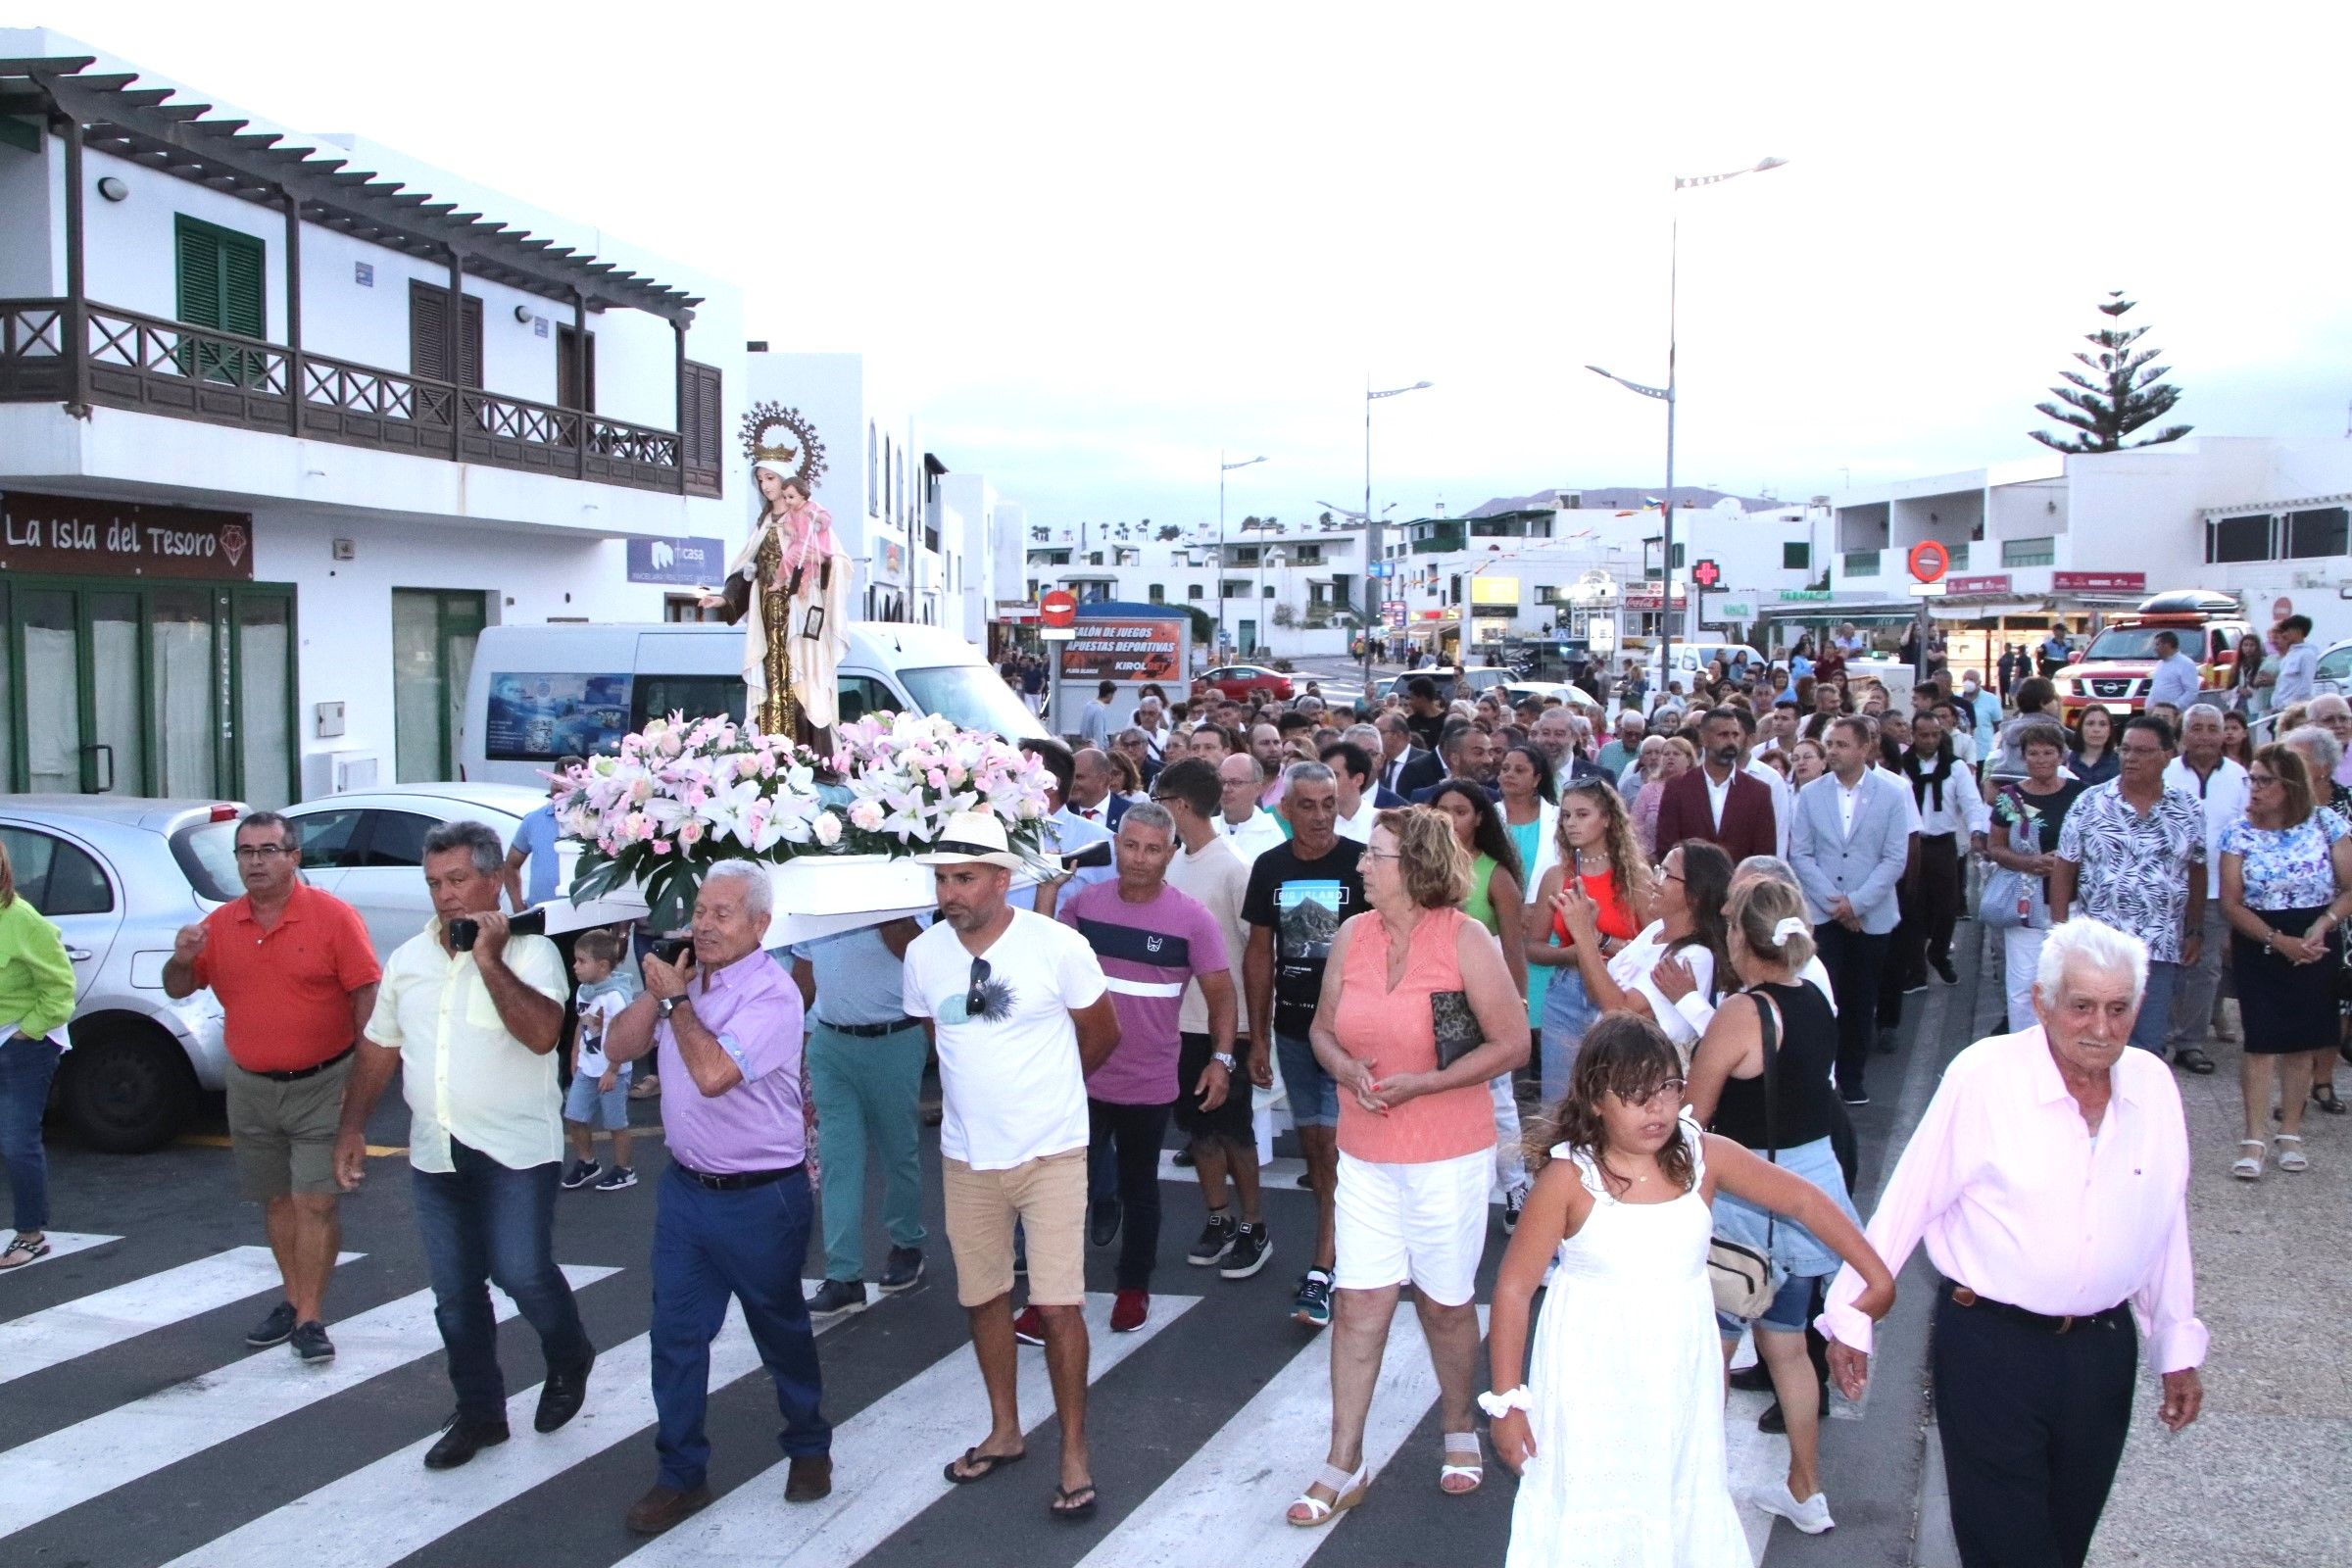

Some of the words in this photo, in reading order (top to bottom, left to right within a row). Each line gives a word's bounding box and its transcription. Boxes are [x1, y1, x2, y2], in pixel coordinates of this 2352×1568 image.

[6, 514, 41, 547] La
[52, 517, 97, 550] Isla
[107, 516, 141, 553] del
[147, 527, 217, 557] Tesoro
[1102, 627, 1116, 637] DE
[1116, 627, 1152, 638] JUEGOS
[1065, 641, 1114, 652] APUESTAS
[1115, 642, 1175, 653] DEPORTIVAS
